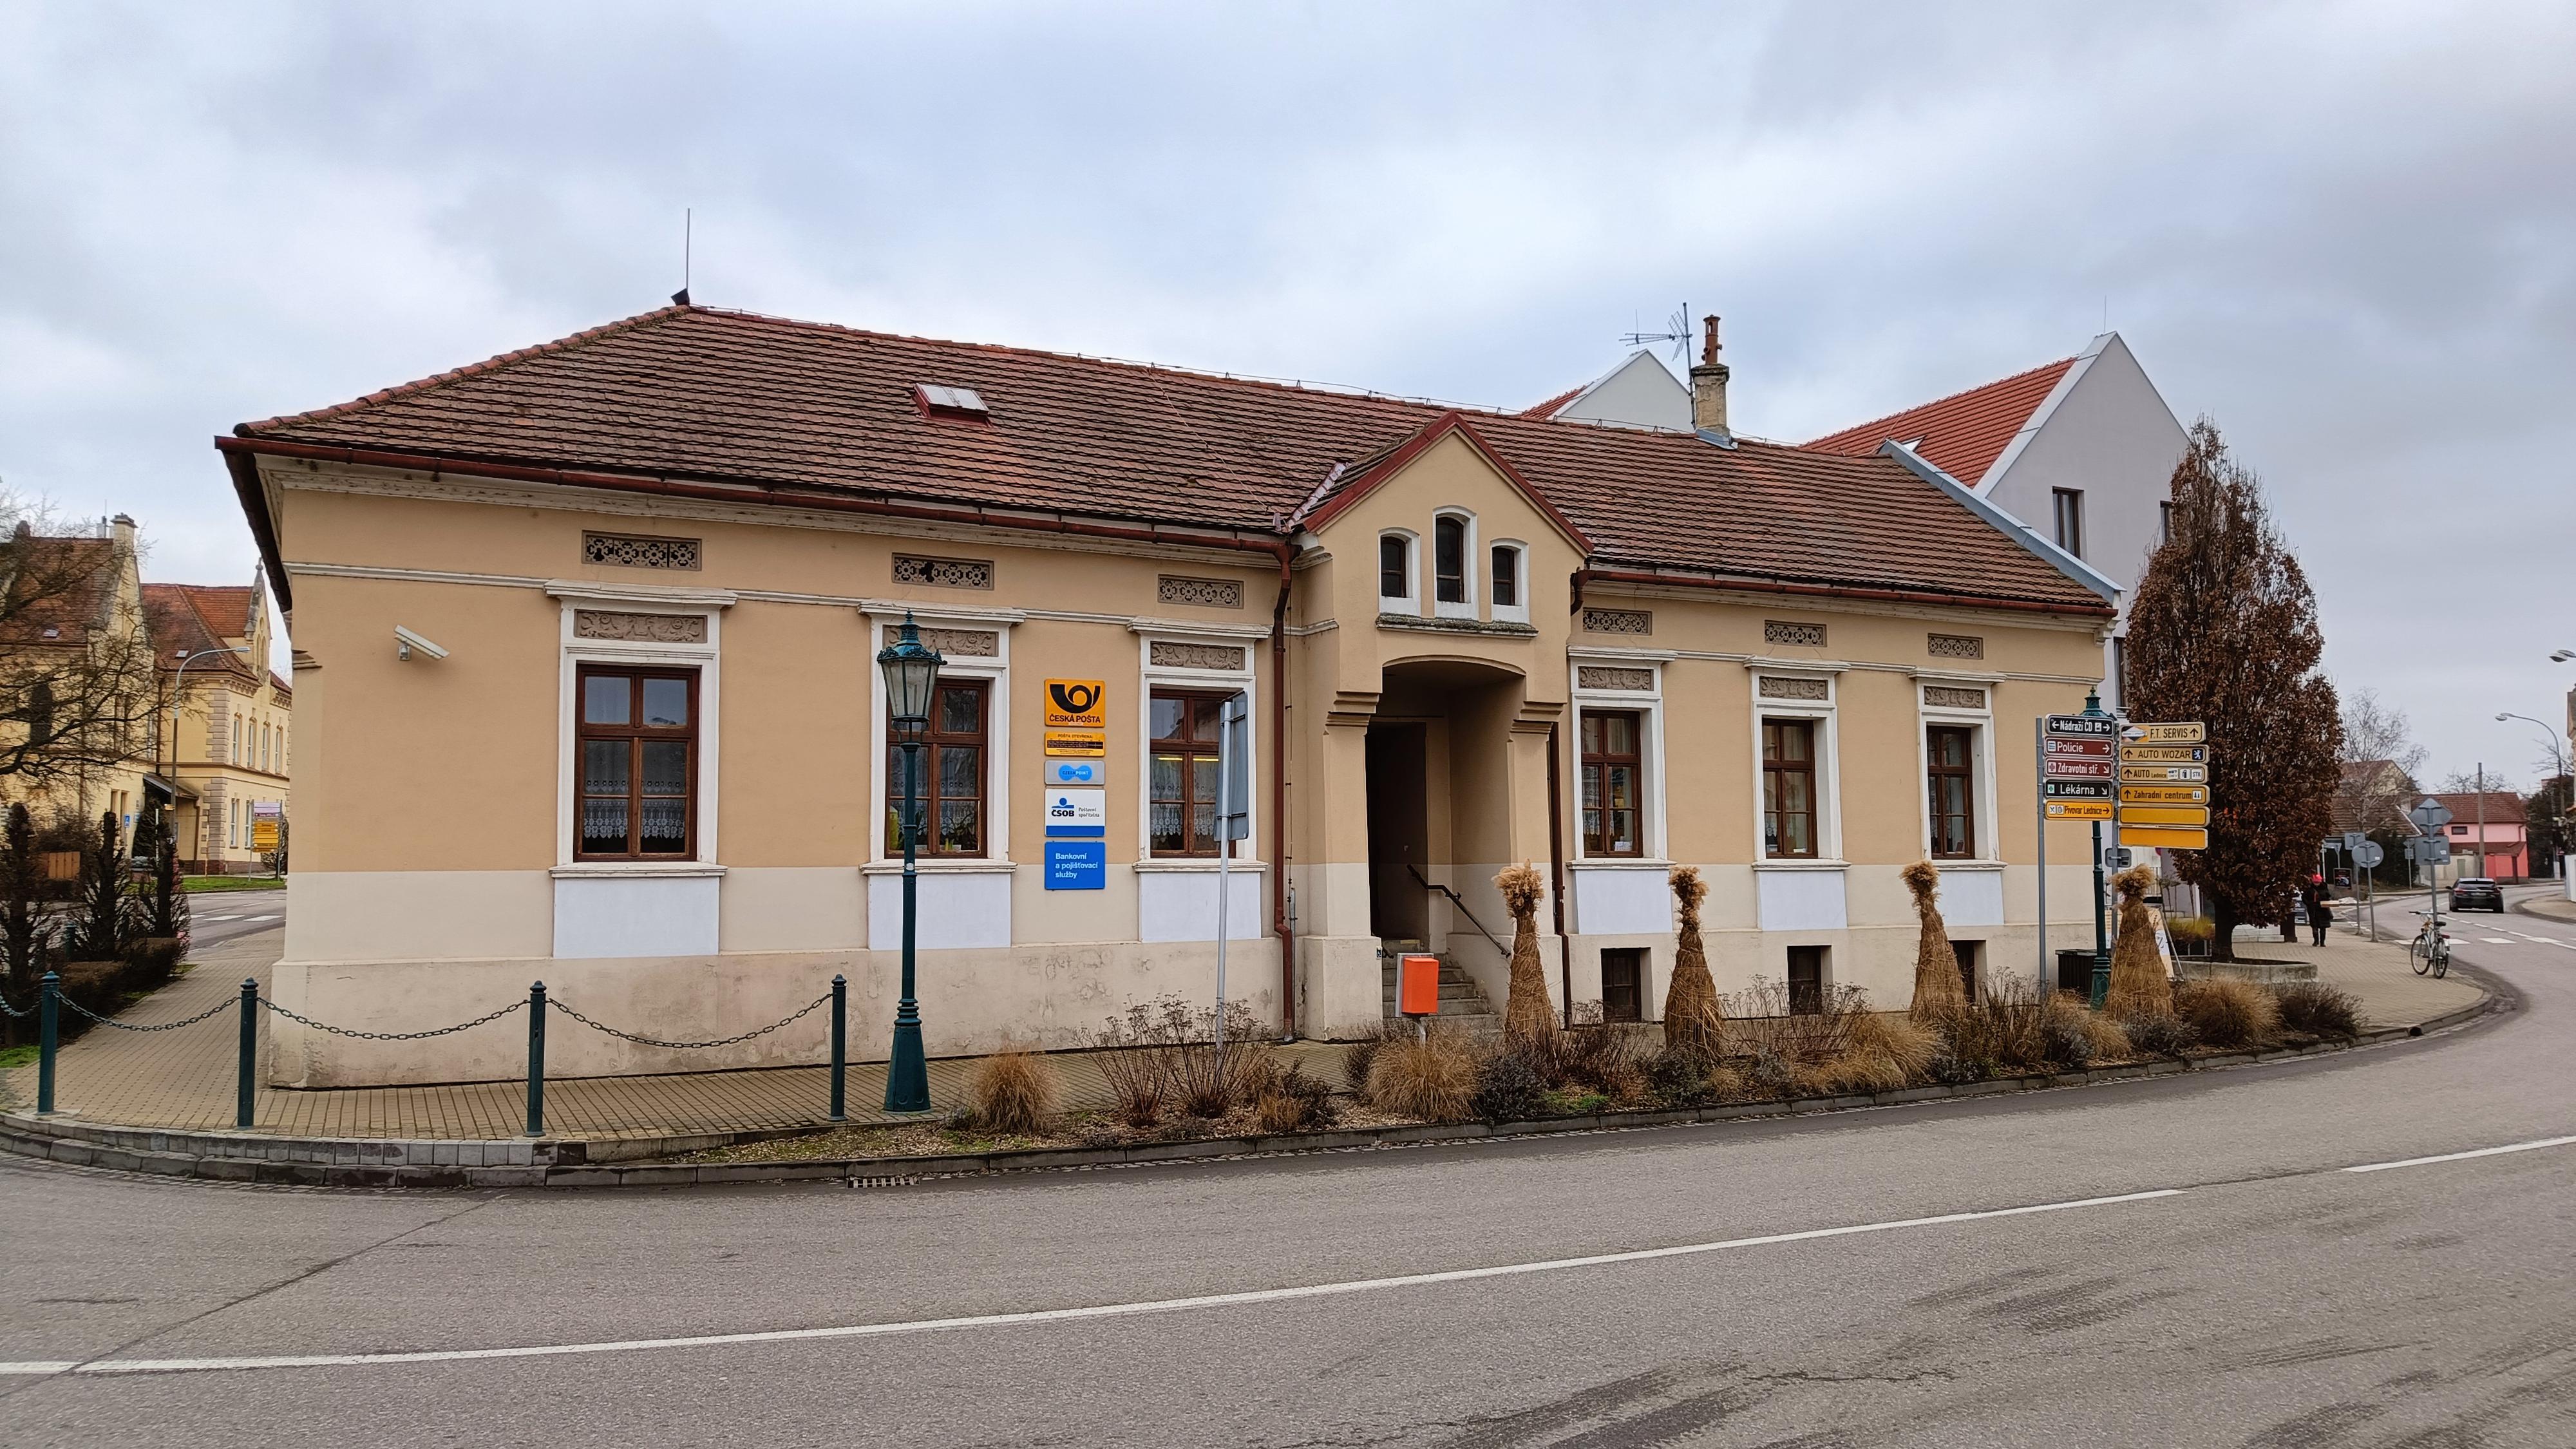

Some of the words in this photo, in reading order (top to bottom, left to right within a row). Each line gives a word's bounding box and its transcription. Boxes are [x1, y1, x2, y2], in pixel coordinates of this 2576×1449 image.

[1049, 714, 1074, 723] ČESKÁ
[1076, 715, 1101, 723] POŠTA
[2060, 719, 2083, 732] Nádraží
[2084, 719, 2092, 732] ČD
[2163, 728, 2188, 738] SERVIS
[2057, 742, 2083, 753] Policie
[2138, 750, 2159, 759] AUTO
[2162, 750, 2190, 759] WOZAR
[2058, 762, 2087, 774] Zdravotní
[2088, 763, 2099, 775] stř.
[2134, 770, 2150, 778] AUTO
[2060, 784, 2095, 795] Lékárna
[2134, 790, 2161, 799] Zahradní
[2164, 791, 2192, 799] centrum
[2064, 806, 2082, 814] Pivovar
[2083, 806, 2103, 815] Lednice
[1061, 862, 1099, 871] pojišťovací
